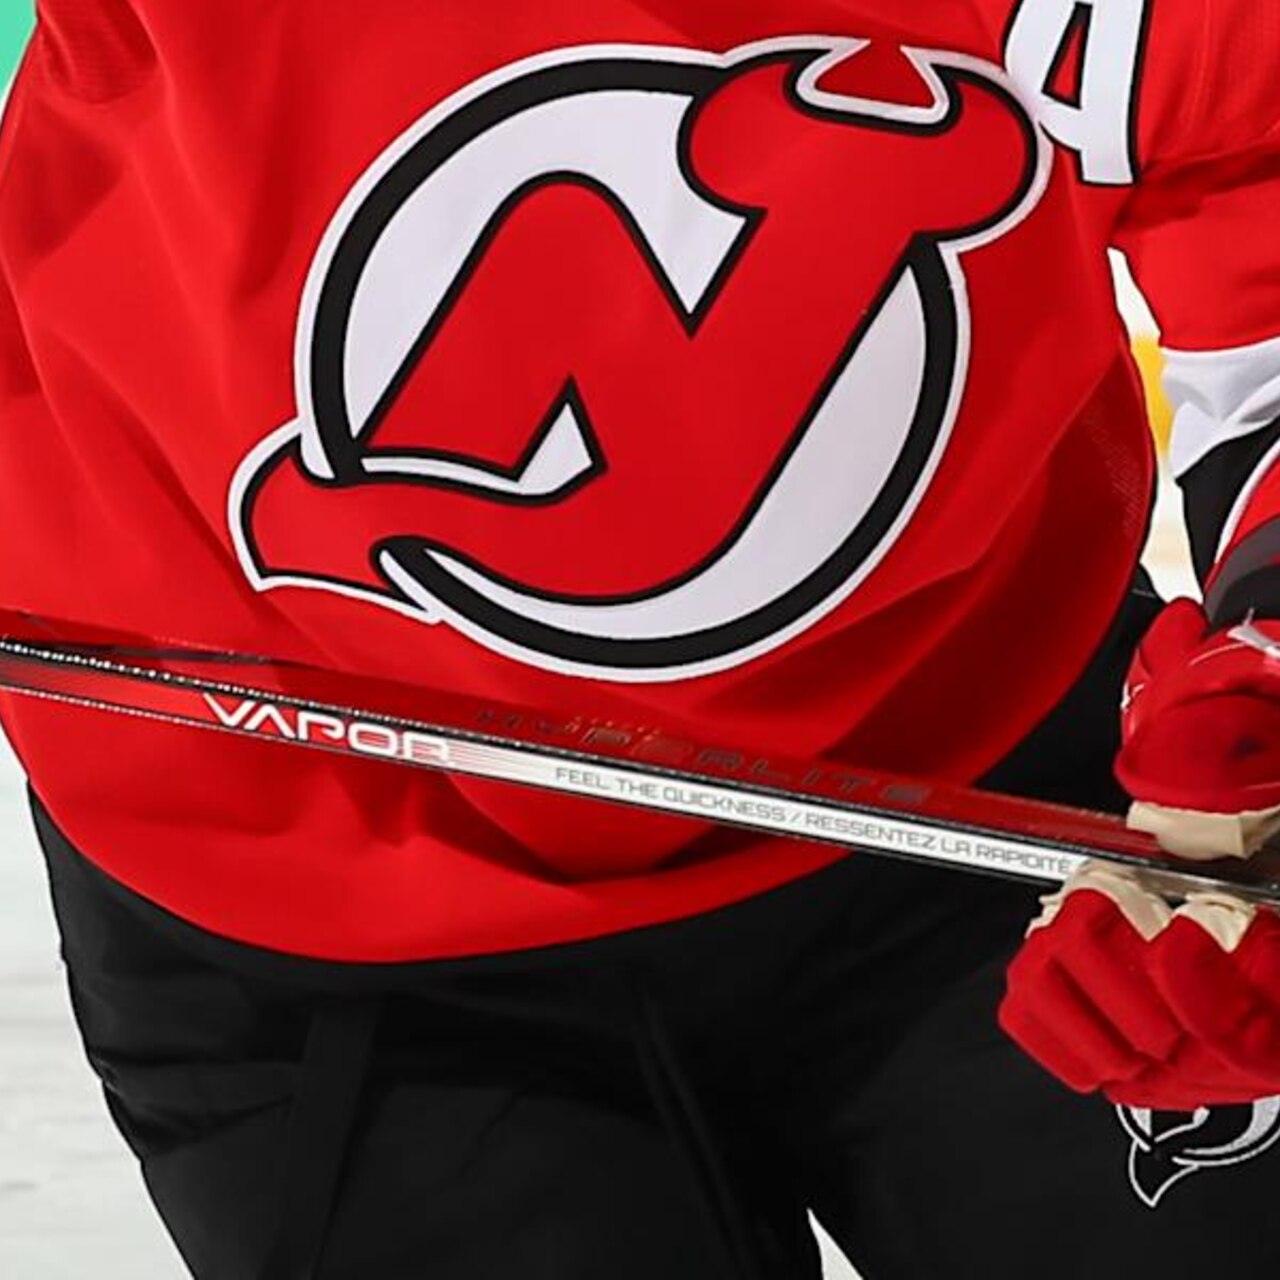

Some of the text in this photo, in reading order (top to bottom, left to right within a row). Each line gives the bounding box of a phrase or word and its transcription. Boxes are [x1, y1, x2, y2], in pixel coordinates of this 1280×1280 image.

[203, 691, 455, 768] VAPOR
[556, 767, 610, 790] FEEL
[616, 777, 658, 800] THE
[662, 785, 786, 823] QUICKNESS
[805, 811, 936, 851] RESSENTEZ
[940, 837, 971, 857] LA
